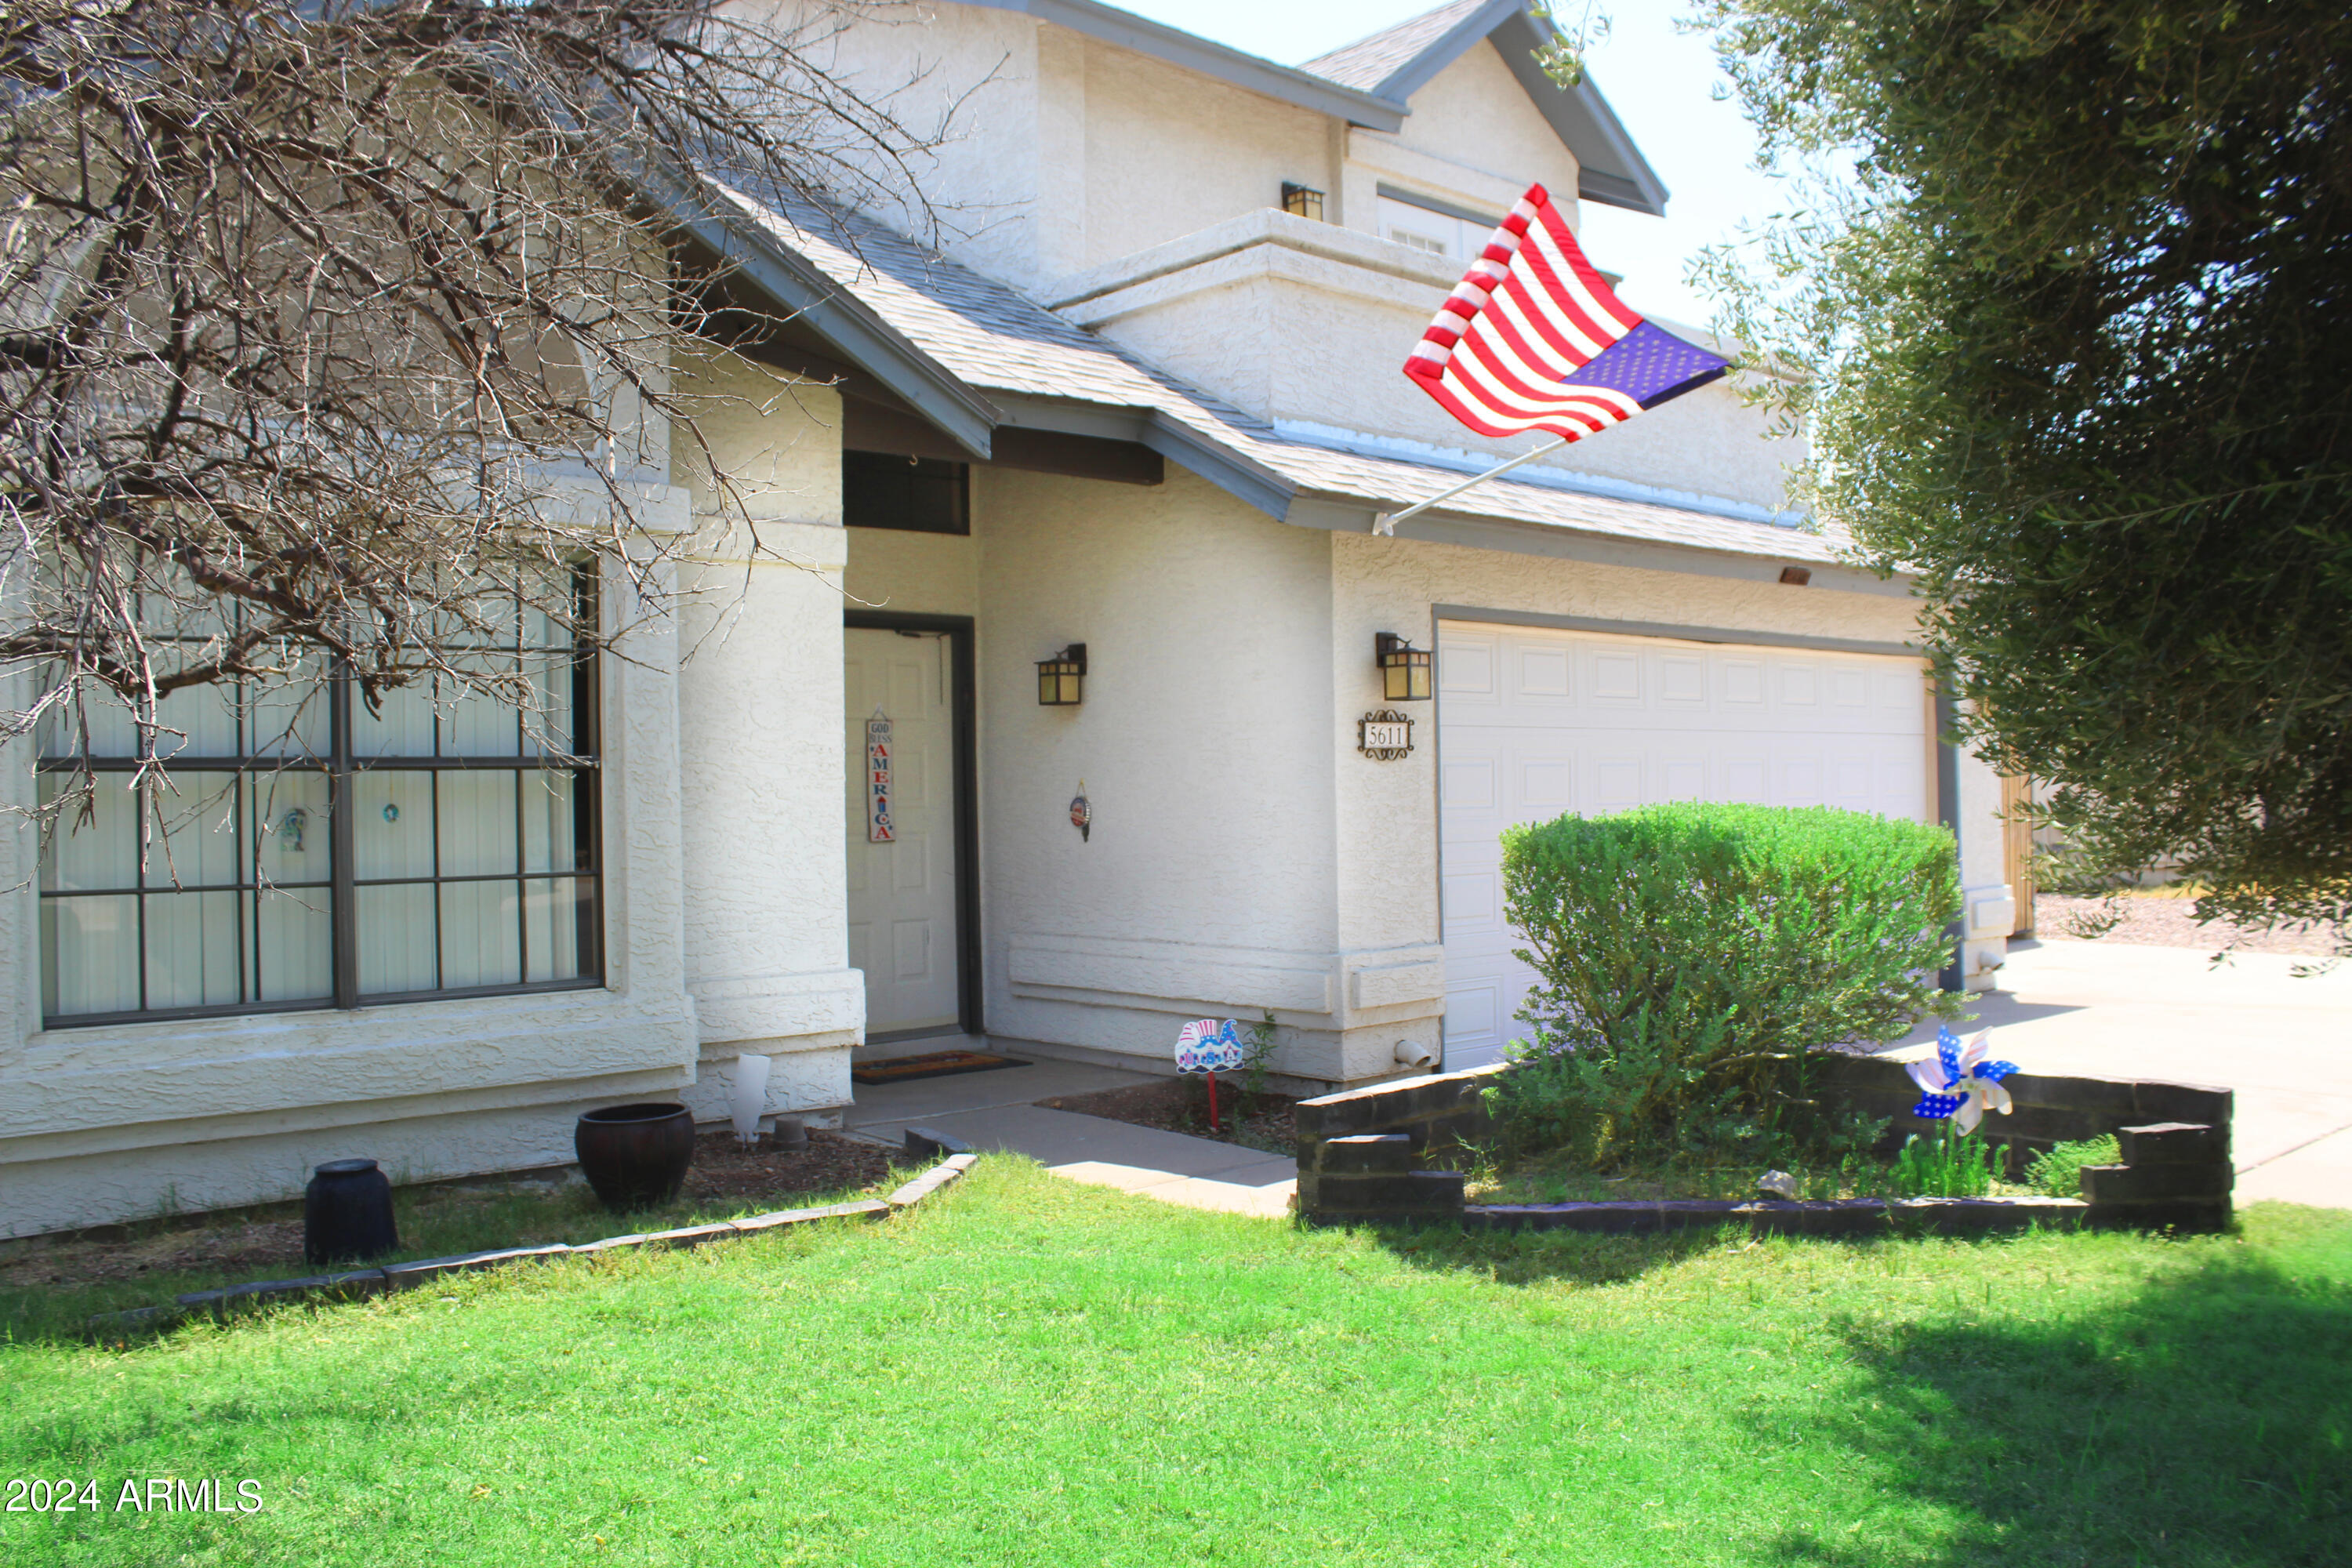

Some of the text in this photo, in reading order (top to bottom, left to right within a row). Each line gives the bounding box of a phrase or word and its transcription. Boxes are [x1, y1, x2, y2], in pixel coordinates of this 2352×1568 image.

[871, 723, 889, 733] GOD
[869, 734, 892, 743] BLESS
[1370, 726, 1402, 745] 5611
[1183, 1048, 1236, 1065] USA
